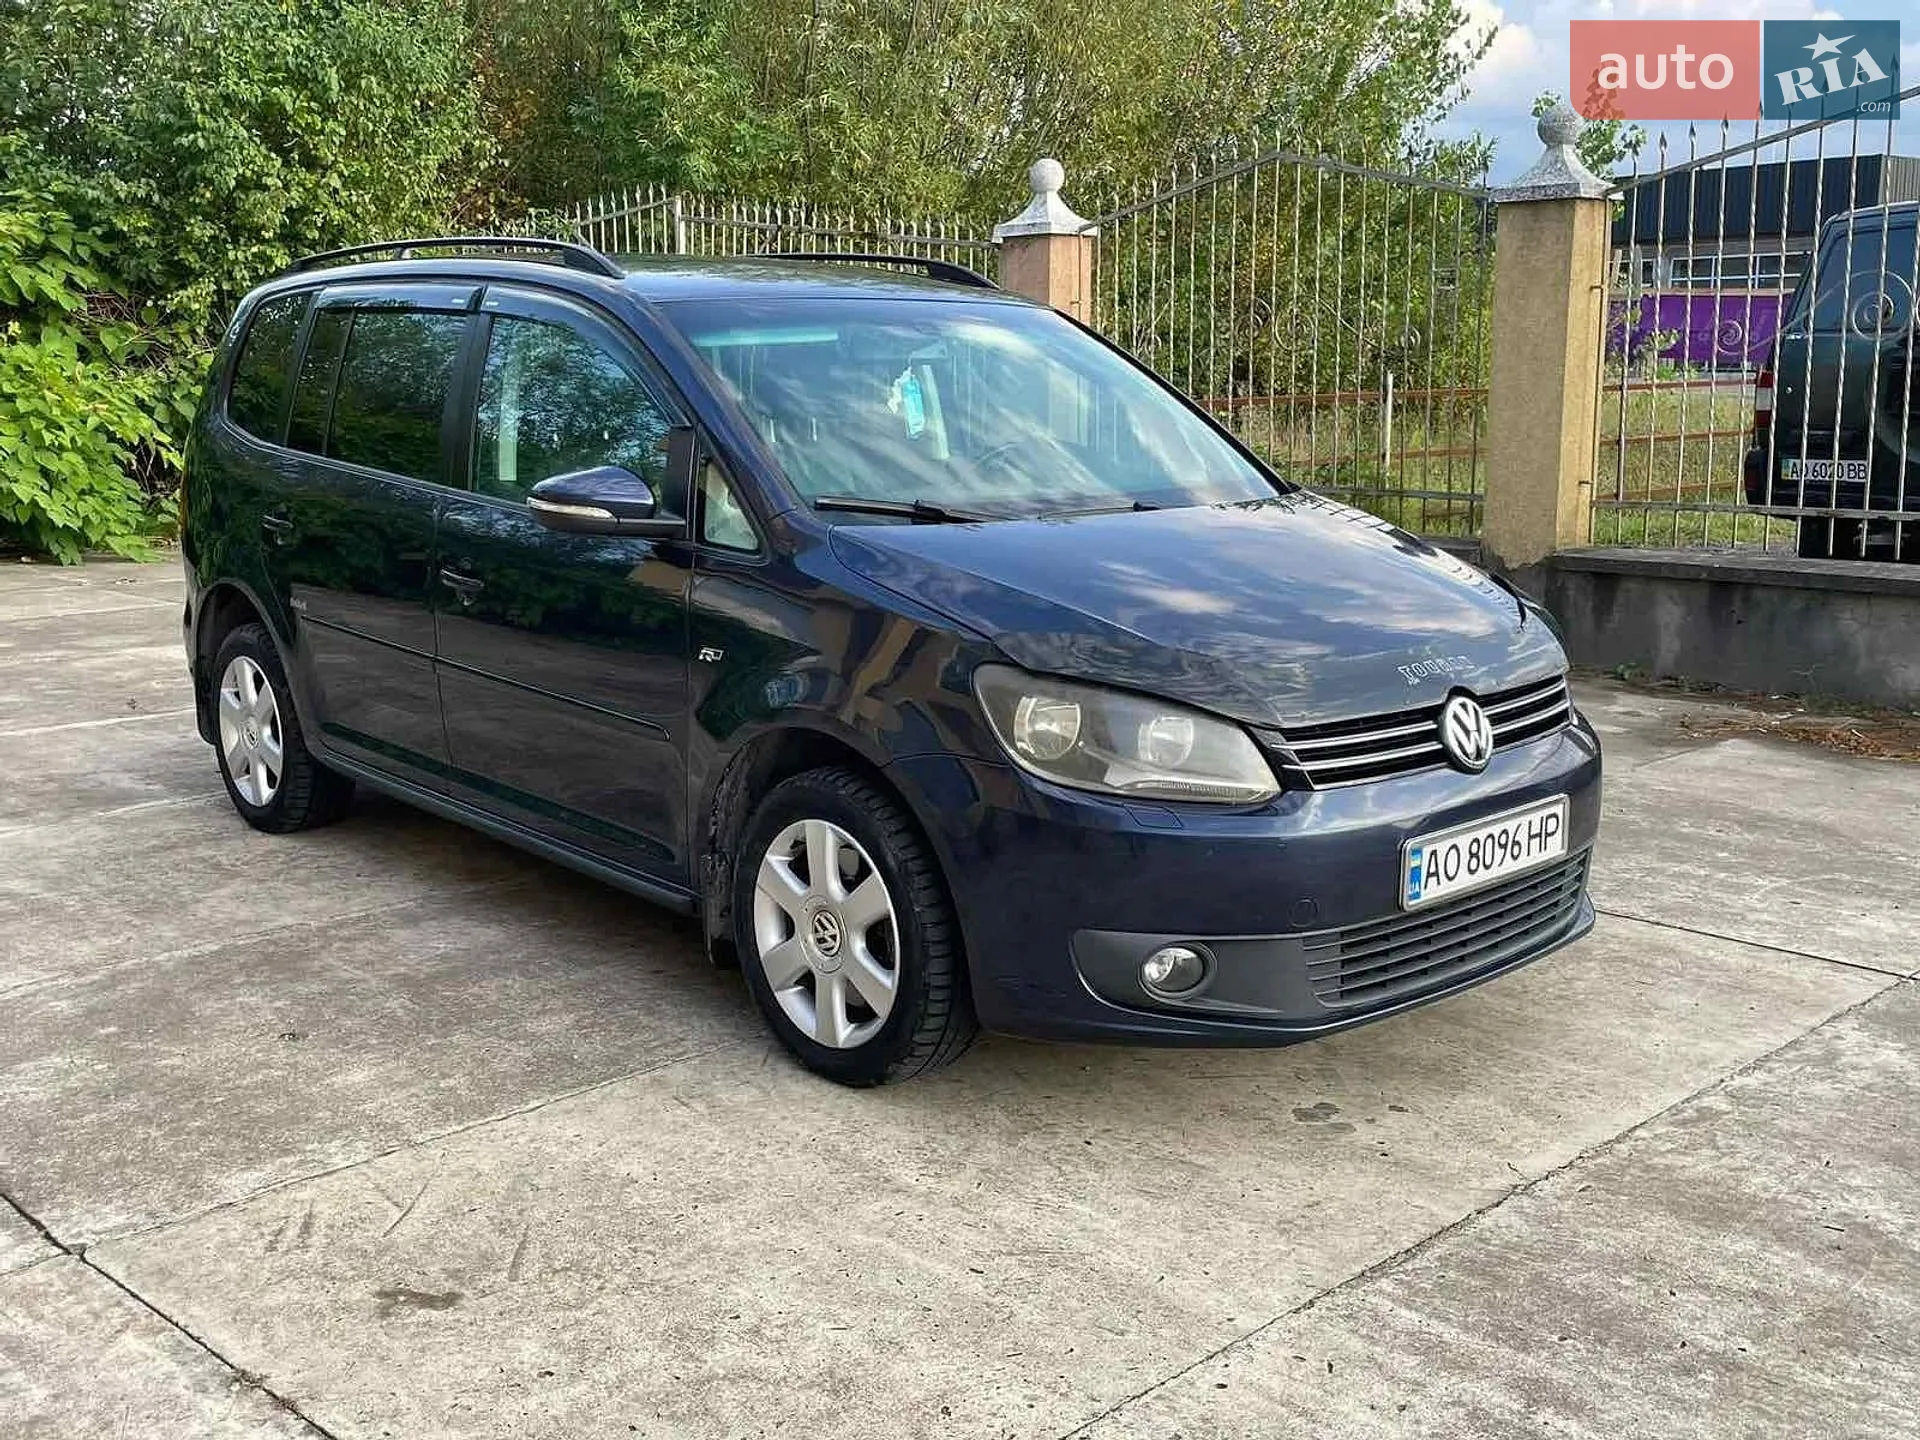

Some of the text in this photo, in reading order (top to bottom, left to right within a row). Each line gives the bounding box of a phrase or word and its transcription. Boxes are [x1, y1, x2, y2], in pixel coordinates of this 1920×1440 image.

[1847, 462, 1867, 480] BB
[1424, 812, 1560, 890] AO 8096 HP
